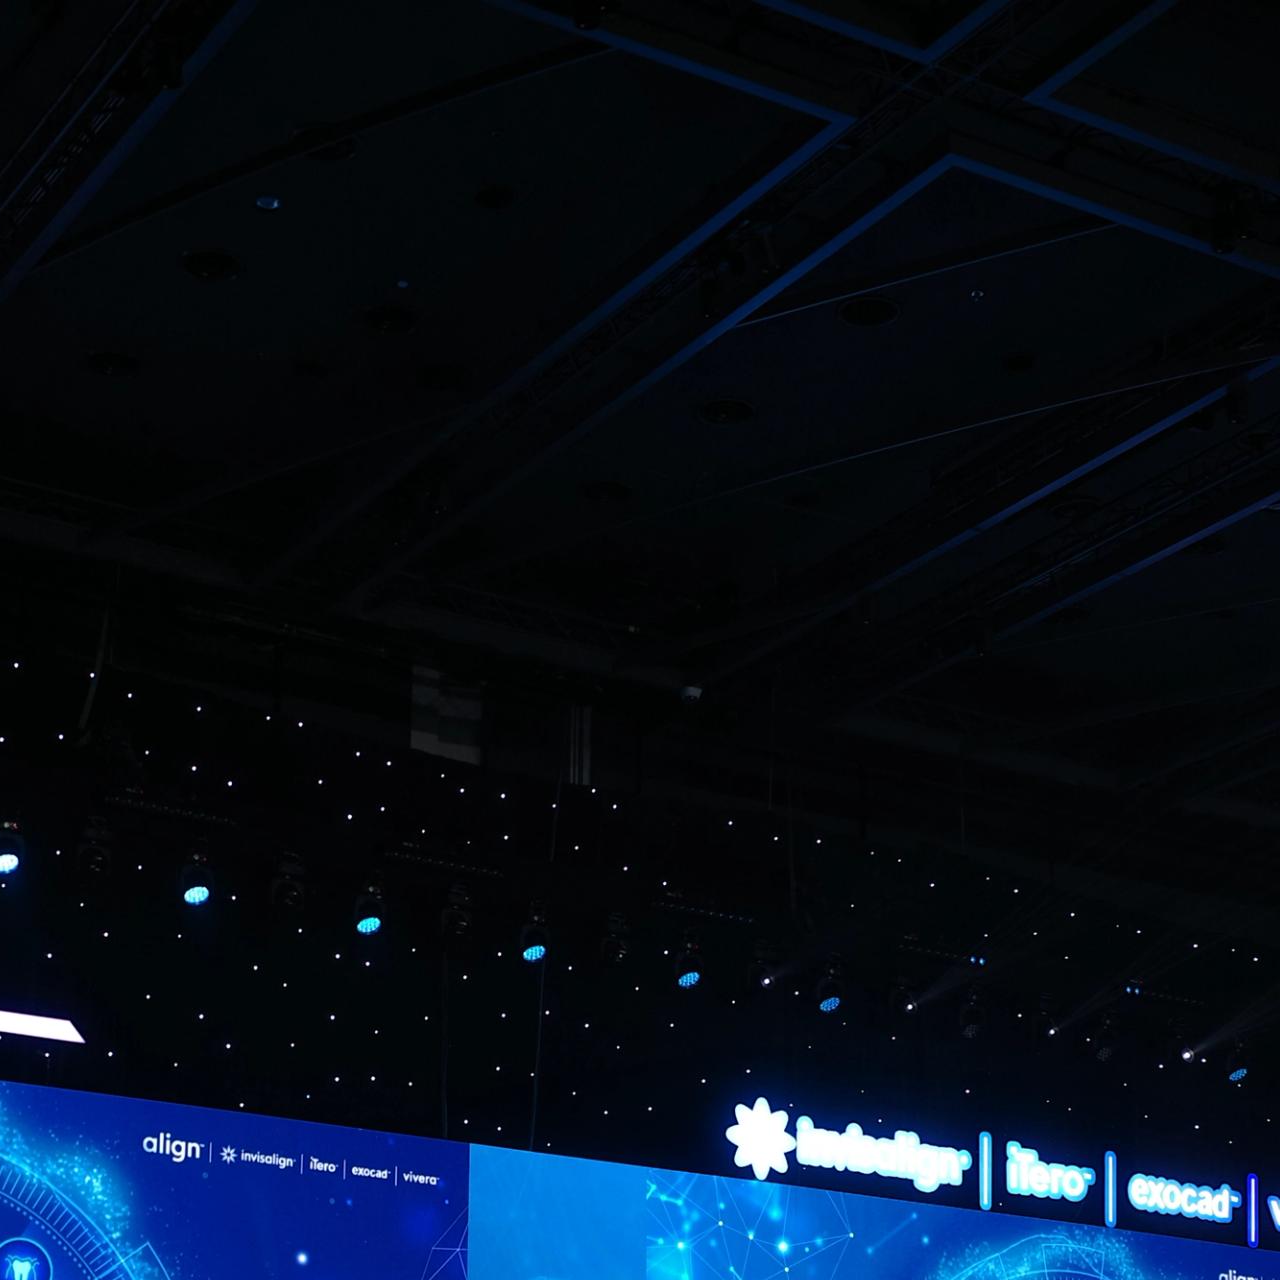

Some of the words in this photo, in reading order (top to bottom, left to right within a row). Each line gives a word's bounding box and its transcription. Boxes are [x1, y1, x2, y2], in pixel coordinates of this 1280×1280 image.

[143, 1132, 200, 1162] align
[241, 1150, 293, 1168] invisalign
[352, 1166, 388, 1180] exocad
[403, 1171, 438, 1186] vivera
[1128, 1174, 1232, 1223] exocad
